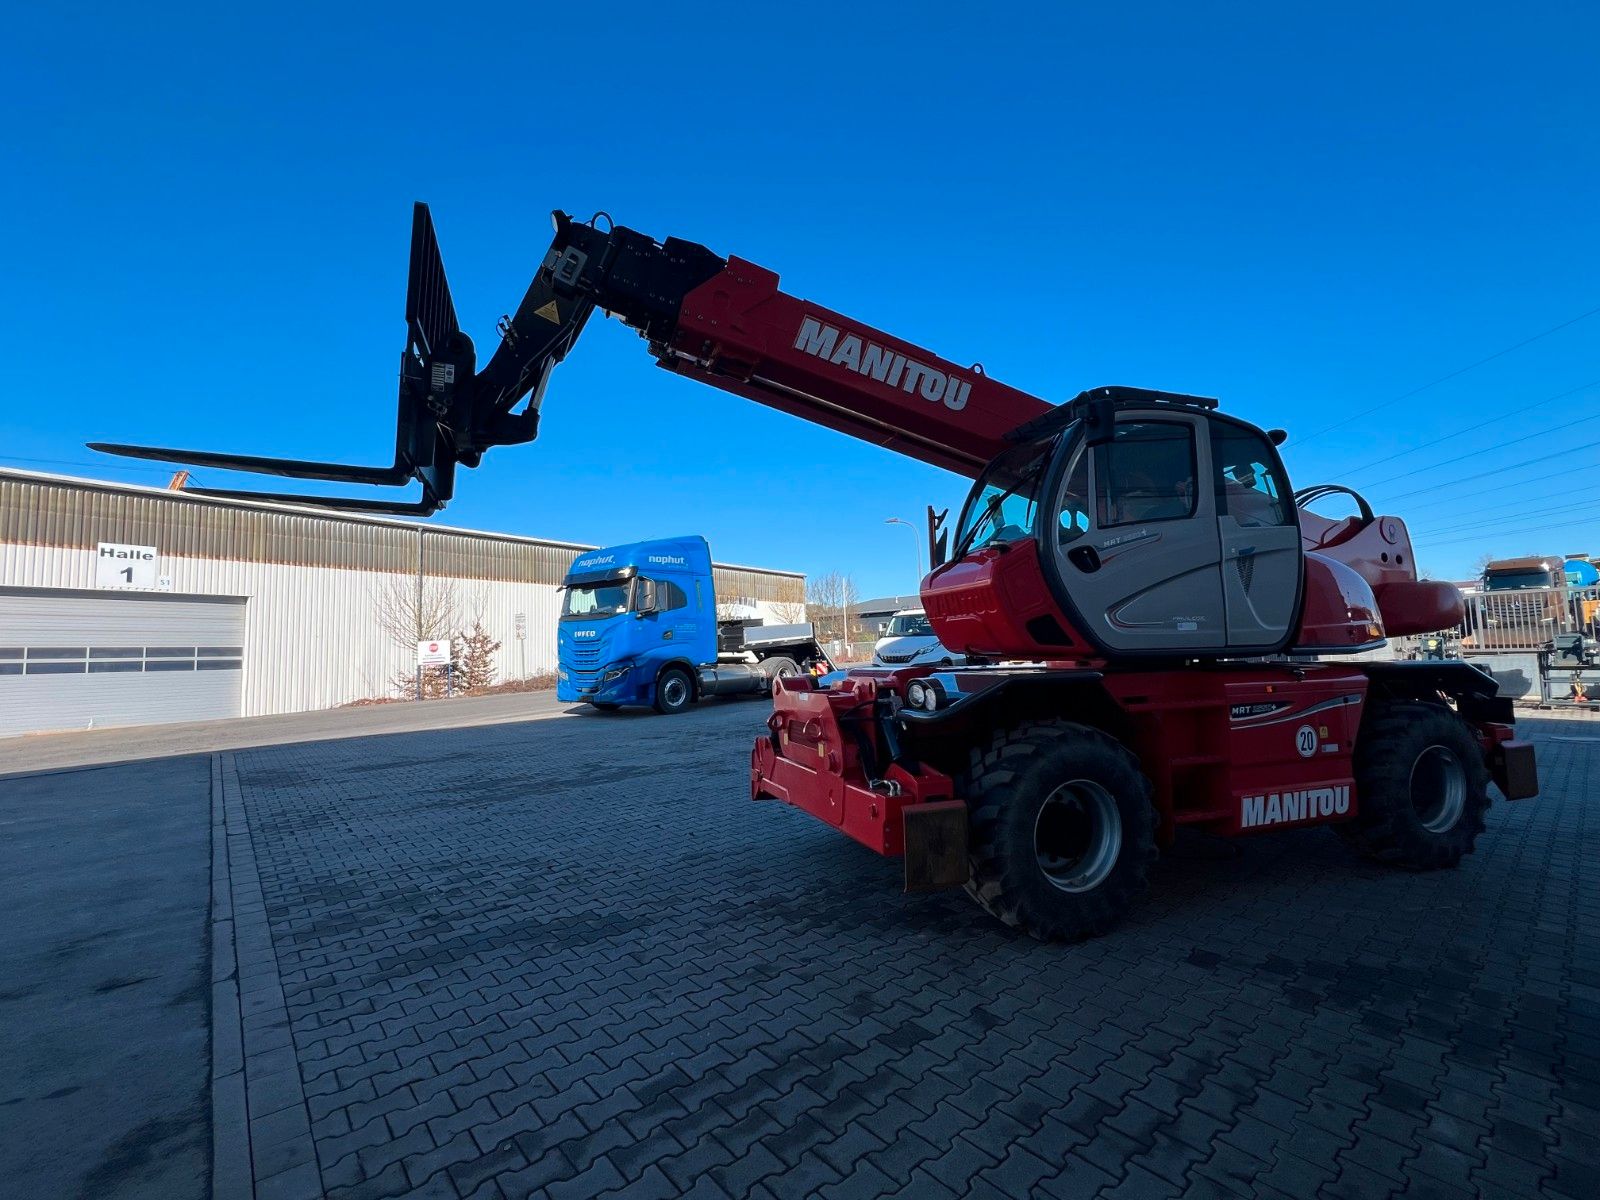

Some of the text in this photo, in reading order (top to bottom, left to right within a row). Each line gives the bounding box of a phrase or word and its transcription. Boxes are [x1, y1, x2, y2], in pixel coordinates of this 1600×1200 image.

[794, 316, 972, 411] MANITOU
[100, 547, 154, 561] Halle
[120, 566, 133, 583] 1
[1231, 706, 1251, 715] MRT
[1300, 731, 1314, 751] 20
[1241, 785, 1350, 828] MANITOU
